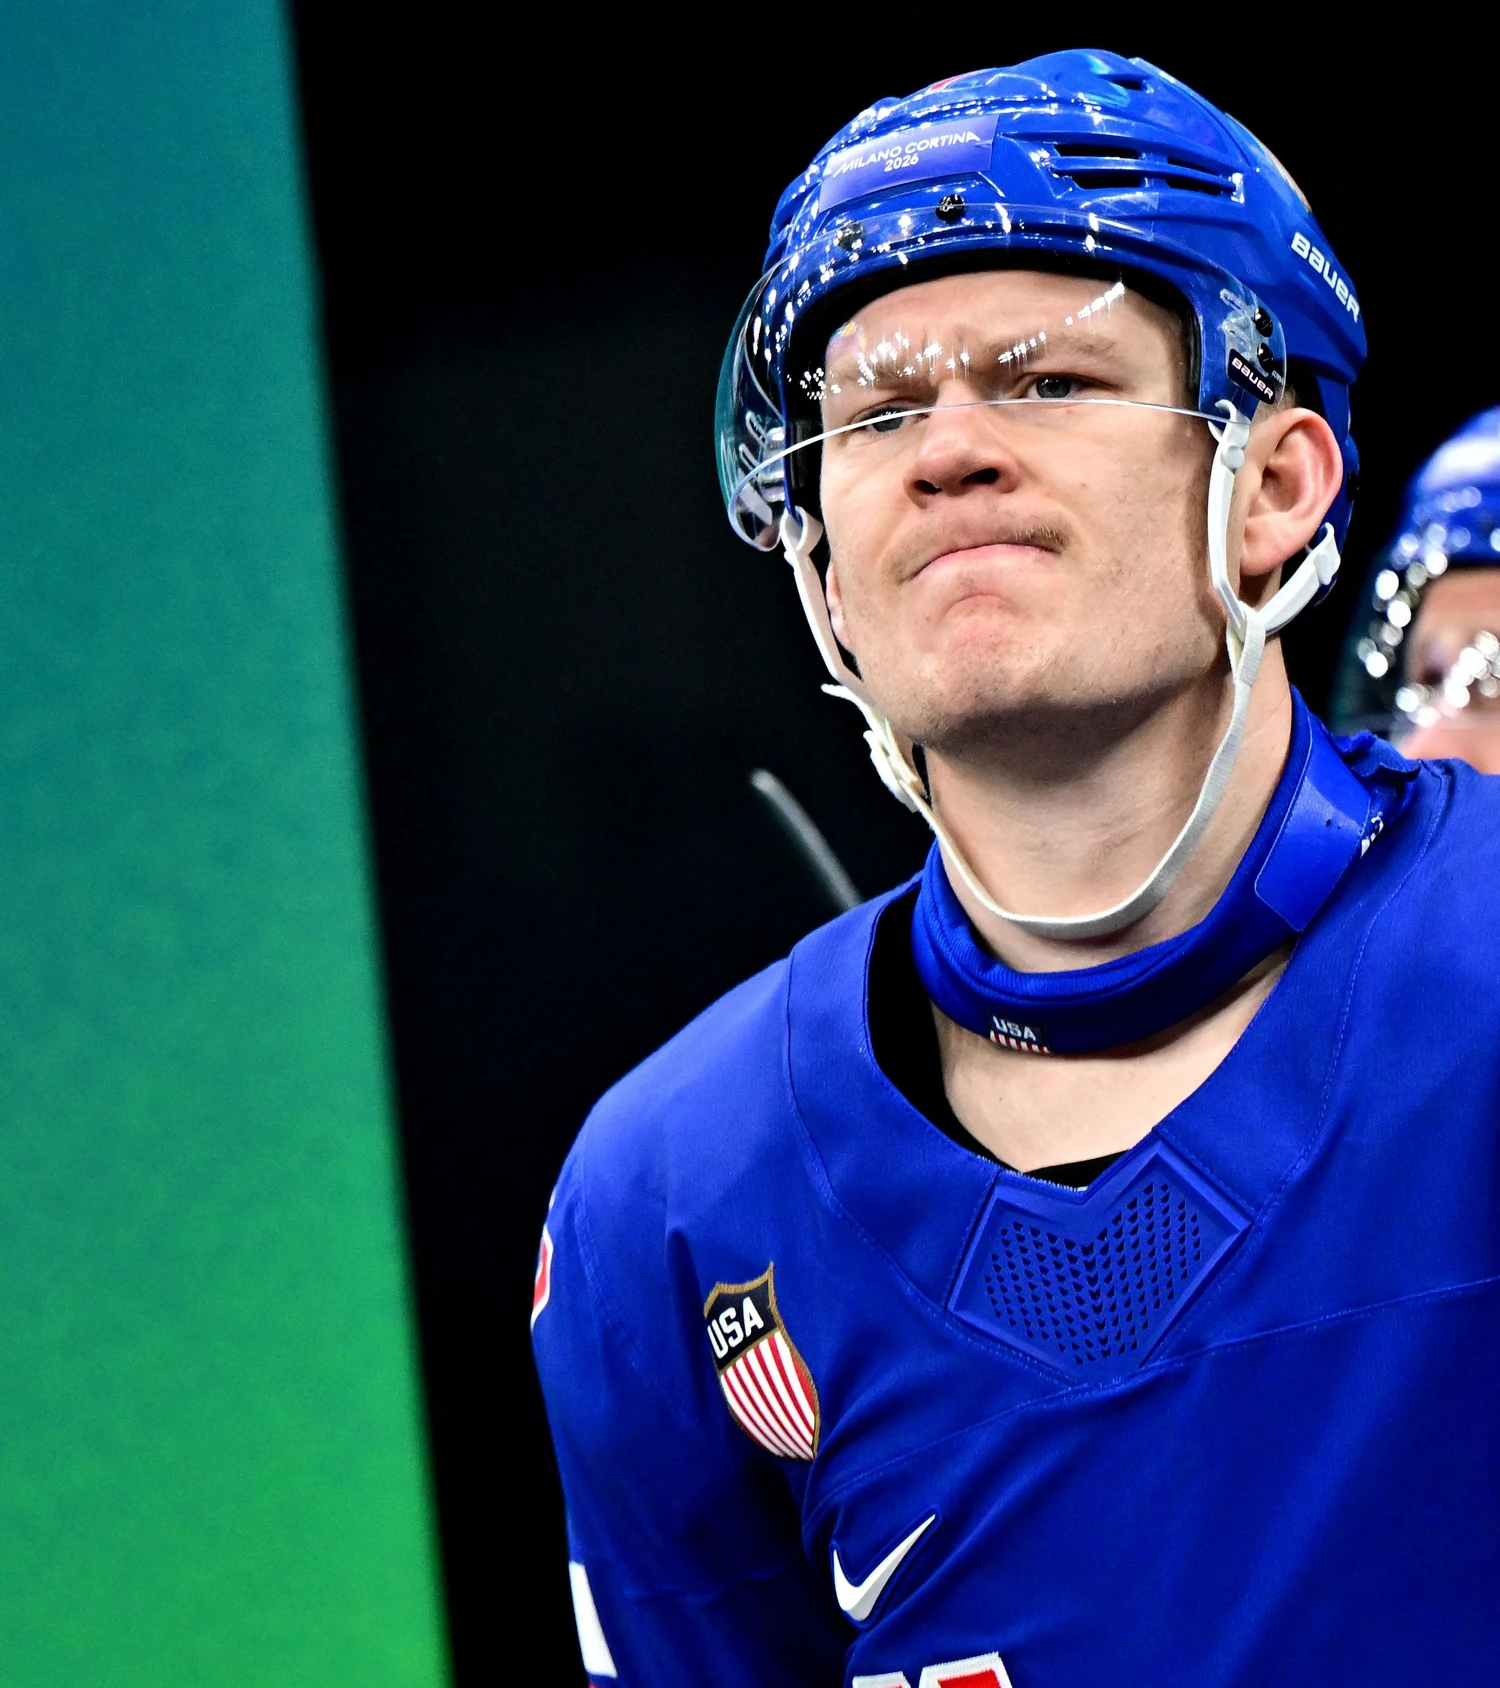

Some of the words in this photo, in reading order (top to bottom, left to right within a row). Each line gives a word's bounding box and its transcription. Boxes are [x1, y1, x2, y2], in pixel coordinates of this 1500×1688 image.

[833, 146, 902, 178] MILANO
[904, 131, 981, 154] CORTINA
[884, 153, 919, 172] 2026
[992, 1015, 1037, 1041] USA
[707, 1296, 764, 1359] USA
